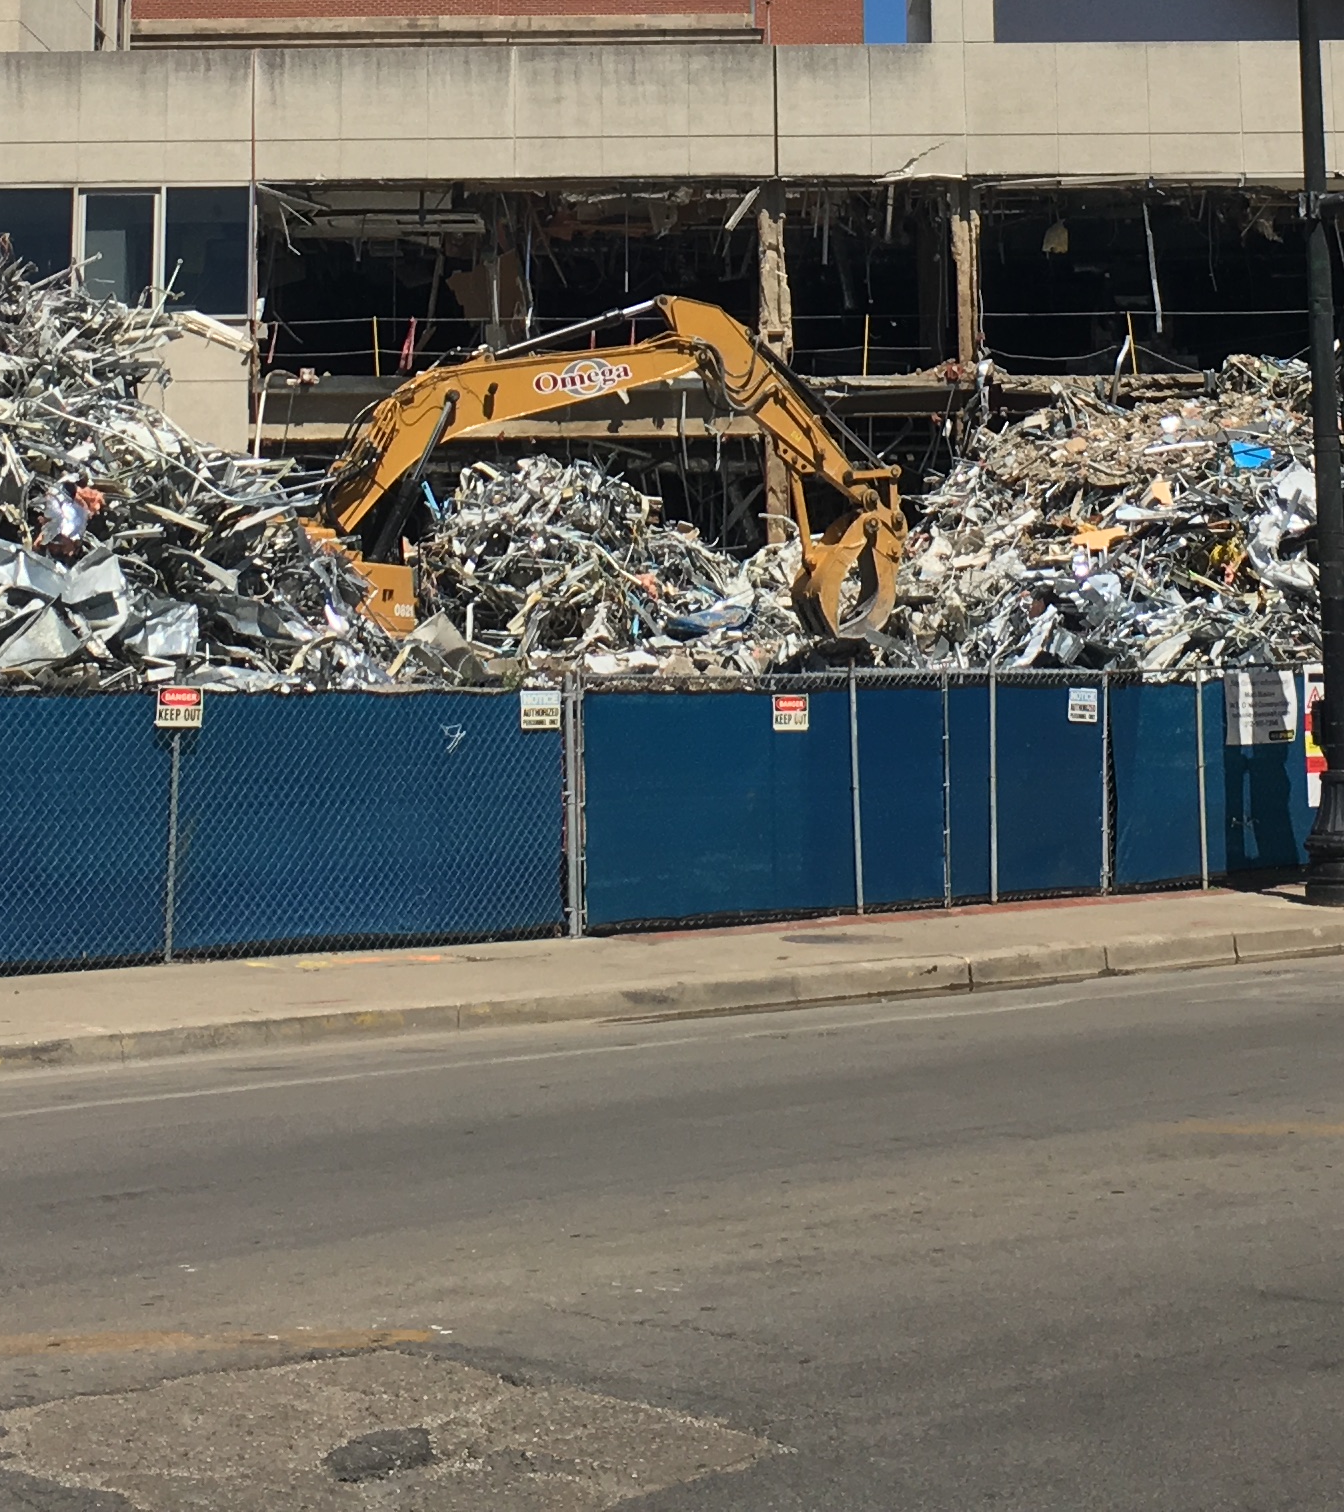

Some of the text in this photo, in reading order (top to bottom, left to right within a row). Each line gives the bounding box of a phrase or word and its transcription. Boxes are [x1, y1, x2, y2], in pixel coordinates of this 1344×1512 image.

[533, 363, 632, 395] Omega
[165, 693, 197, 701] DANGER
[158, 707, 201, 722] KEEP OUT
[774, 713, 792, 725] KEEP
